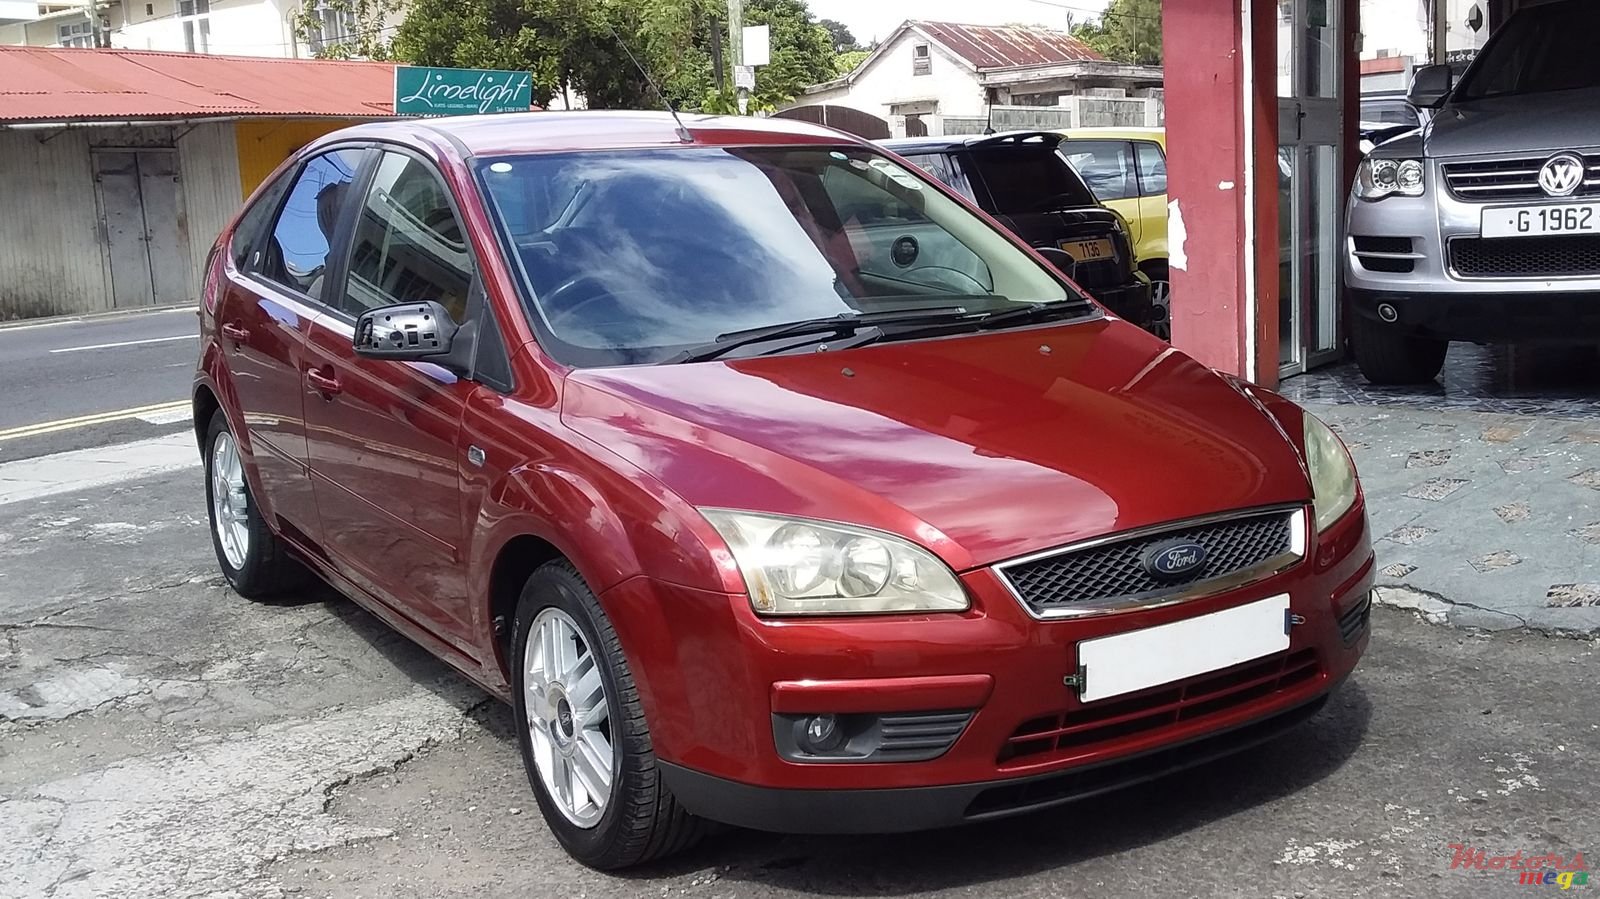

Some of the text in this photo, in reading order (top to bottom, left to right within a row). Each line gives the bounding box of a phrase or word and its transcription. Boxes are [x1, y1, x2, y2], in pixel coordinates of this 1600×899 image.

[400, 70, 529, 113] Limelight
[1518, 207, 1593, 232] G 1962
[1079, 242, 1100, 258] 7136
[1166, 548, 1197, 570] Ford
